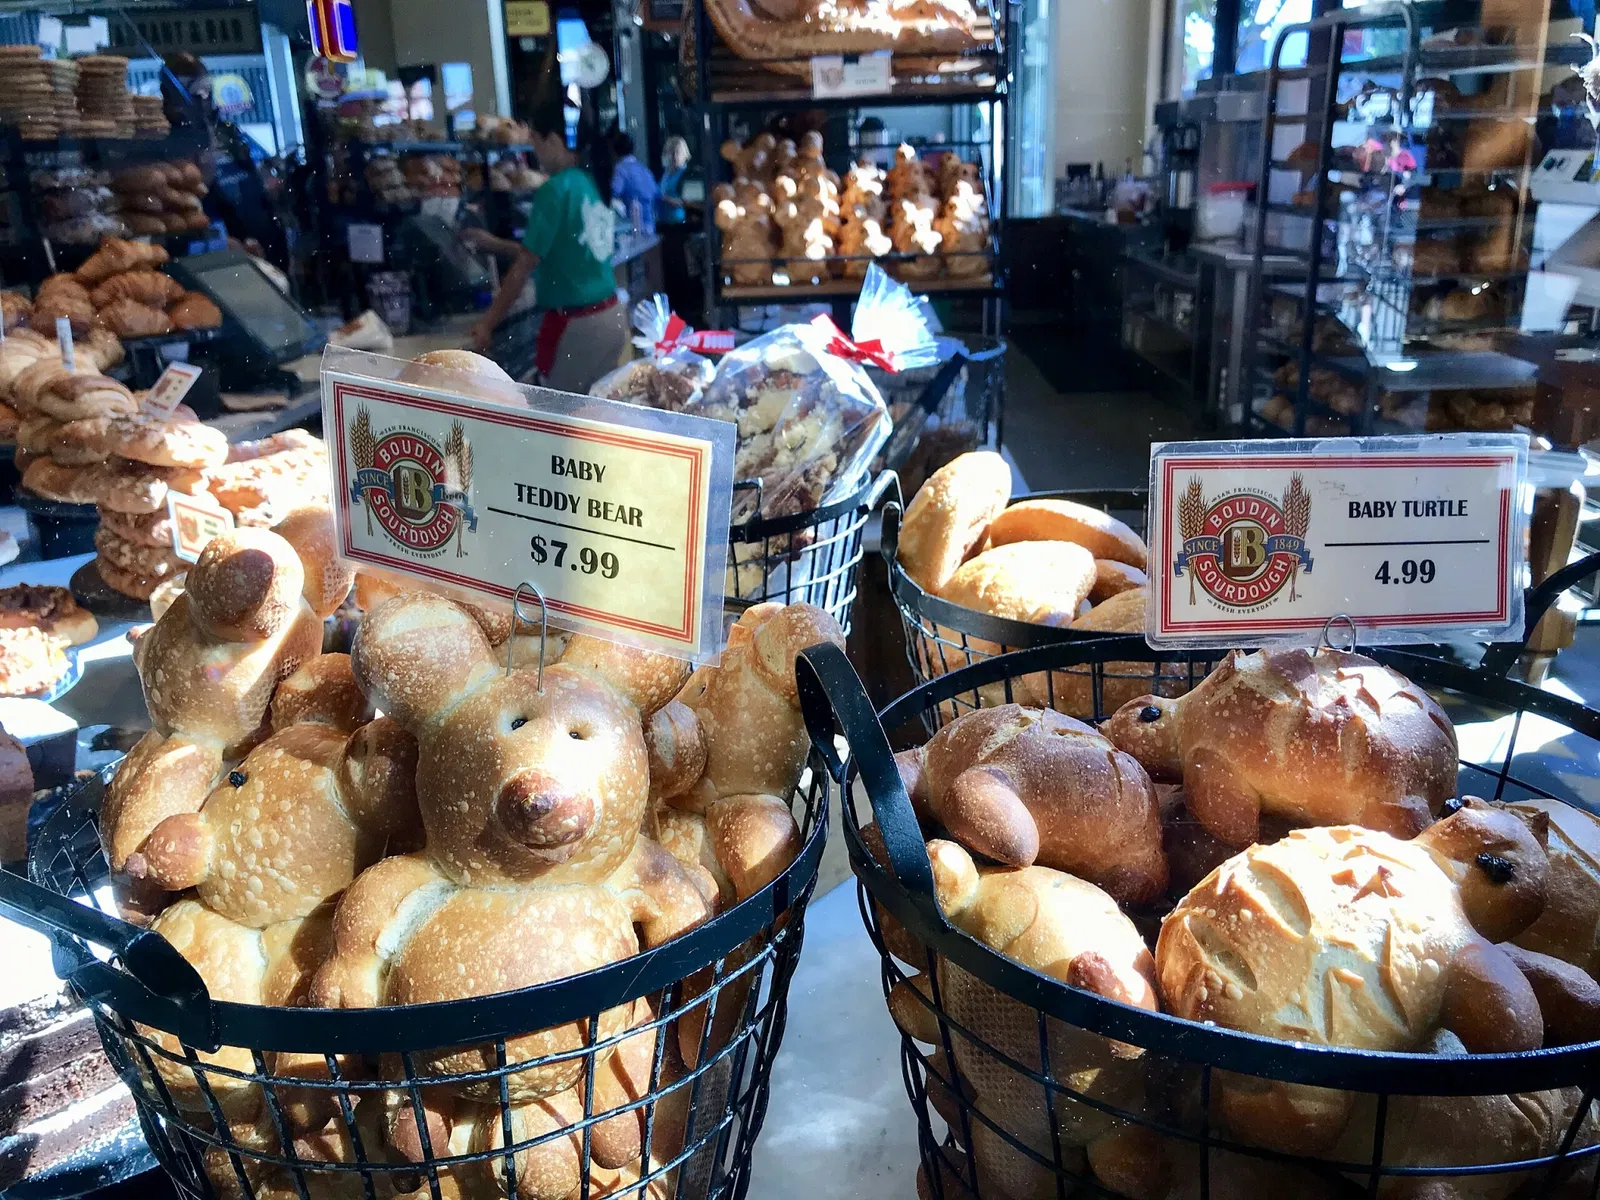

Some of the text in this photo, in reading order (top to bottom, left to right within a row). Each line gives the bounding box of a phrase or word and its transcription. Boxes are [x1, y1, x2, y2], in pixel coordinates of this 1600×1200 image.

[384, 425, 437, 443] SAN FRANCISCO
[379, 440, 445, 476] BOUDIN
[551, 455, 606, 483] BABY
[360, 471, 390, 486] SINCE
[514, 482, 643, 527] TEDDY BEAR
[1217, 487, 1274, 499] SAN FRANCISCO
[374, 494, 454, 545] SOURDOUGH
[1209, 501, 1280, 528] BOUDIN
[1348, 499, 1468, 518] BABY TURTLE
[388, 535, 443, 559] FRESH EVERYDAY
[530, 534, 620, 580] $7.99
[1185, 539, 1300, 555] SINCE 1849
[1199, 559, 1288, 601] SOURDOUGH
[1374, 559, 1436, 585] 4.99
[1213, 600, 1273, 614] FRESH EVERYDAY
